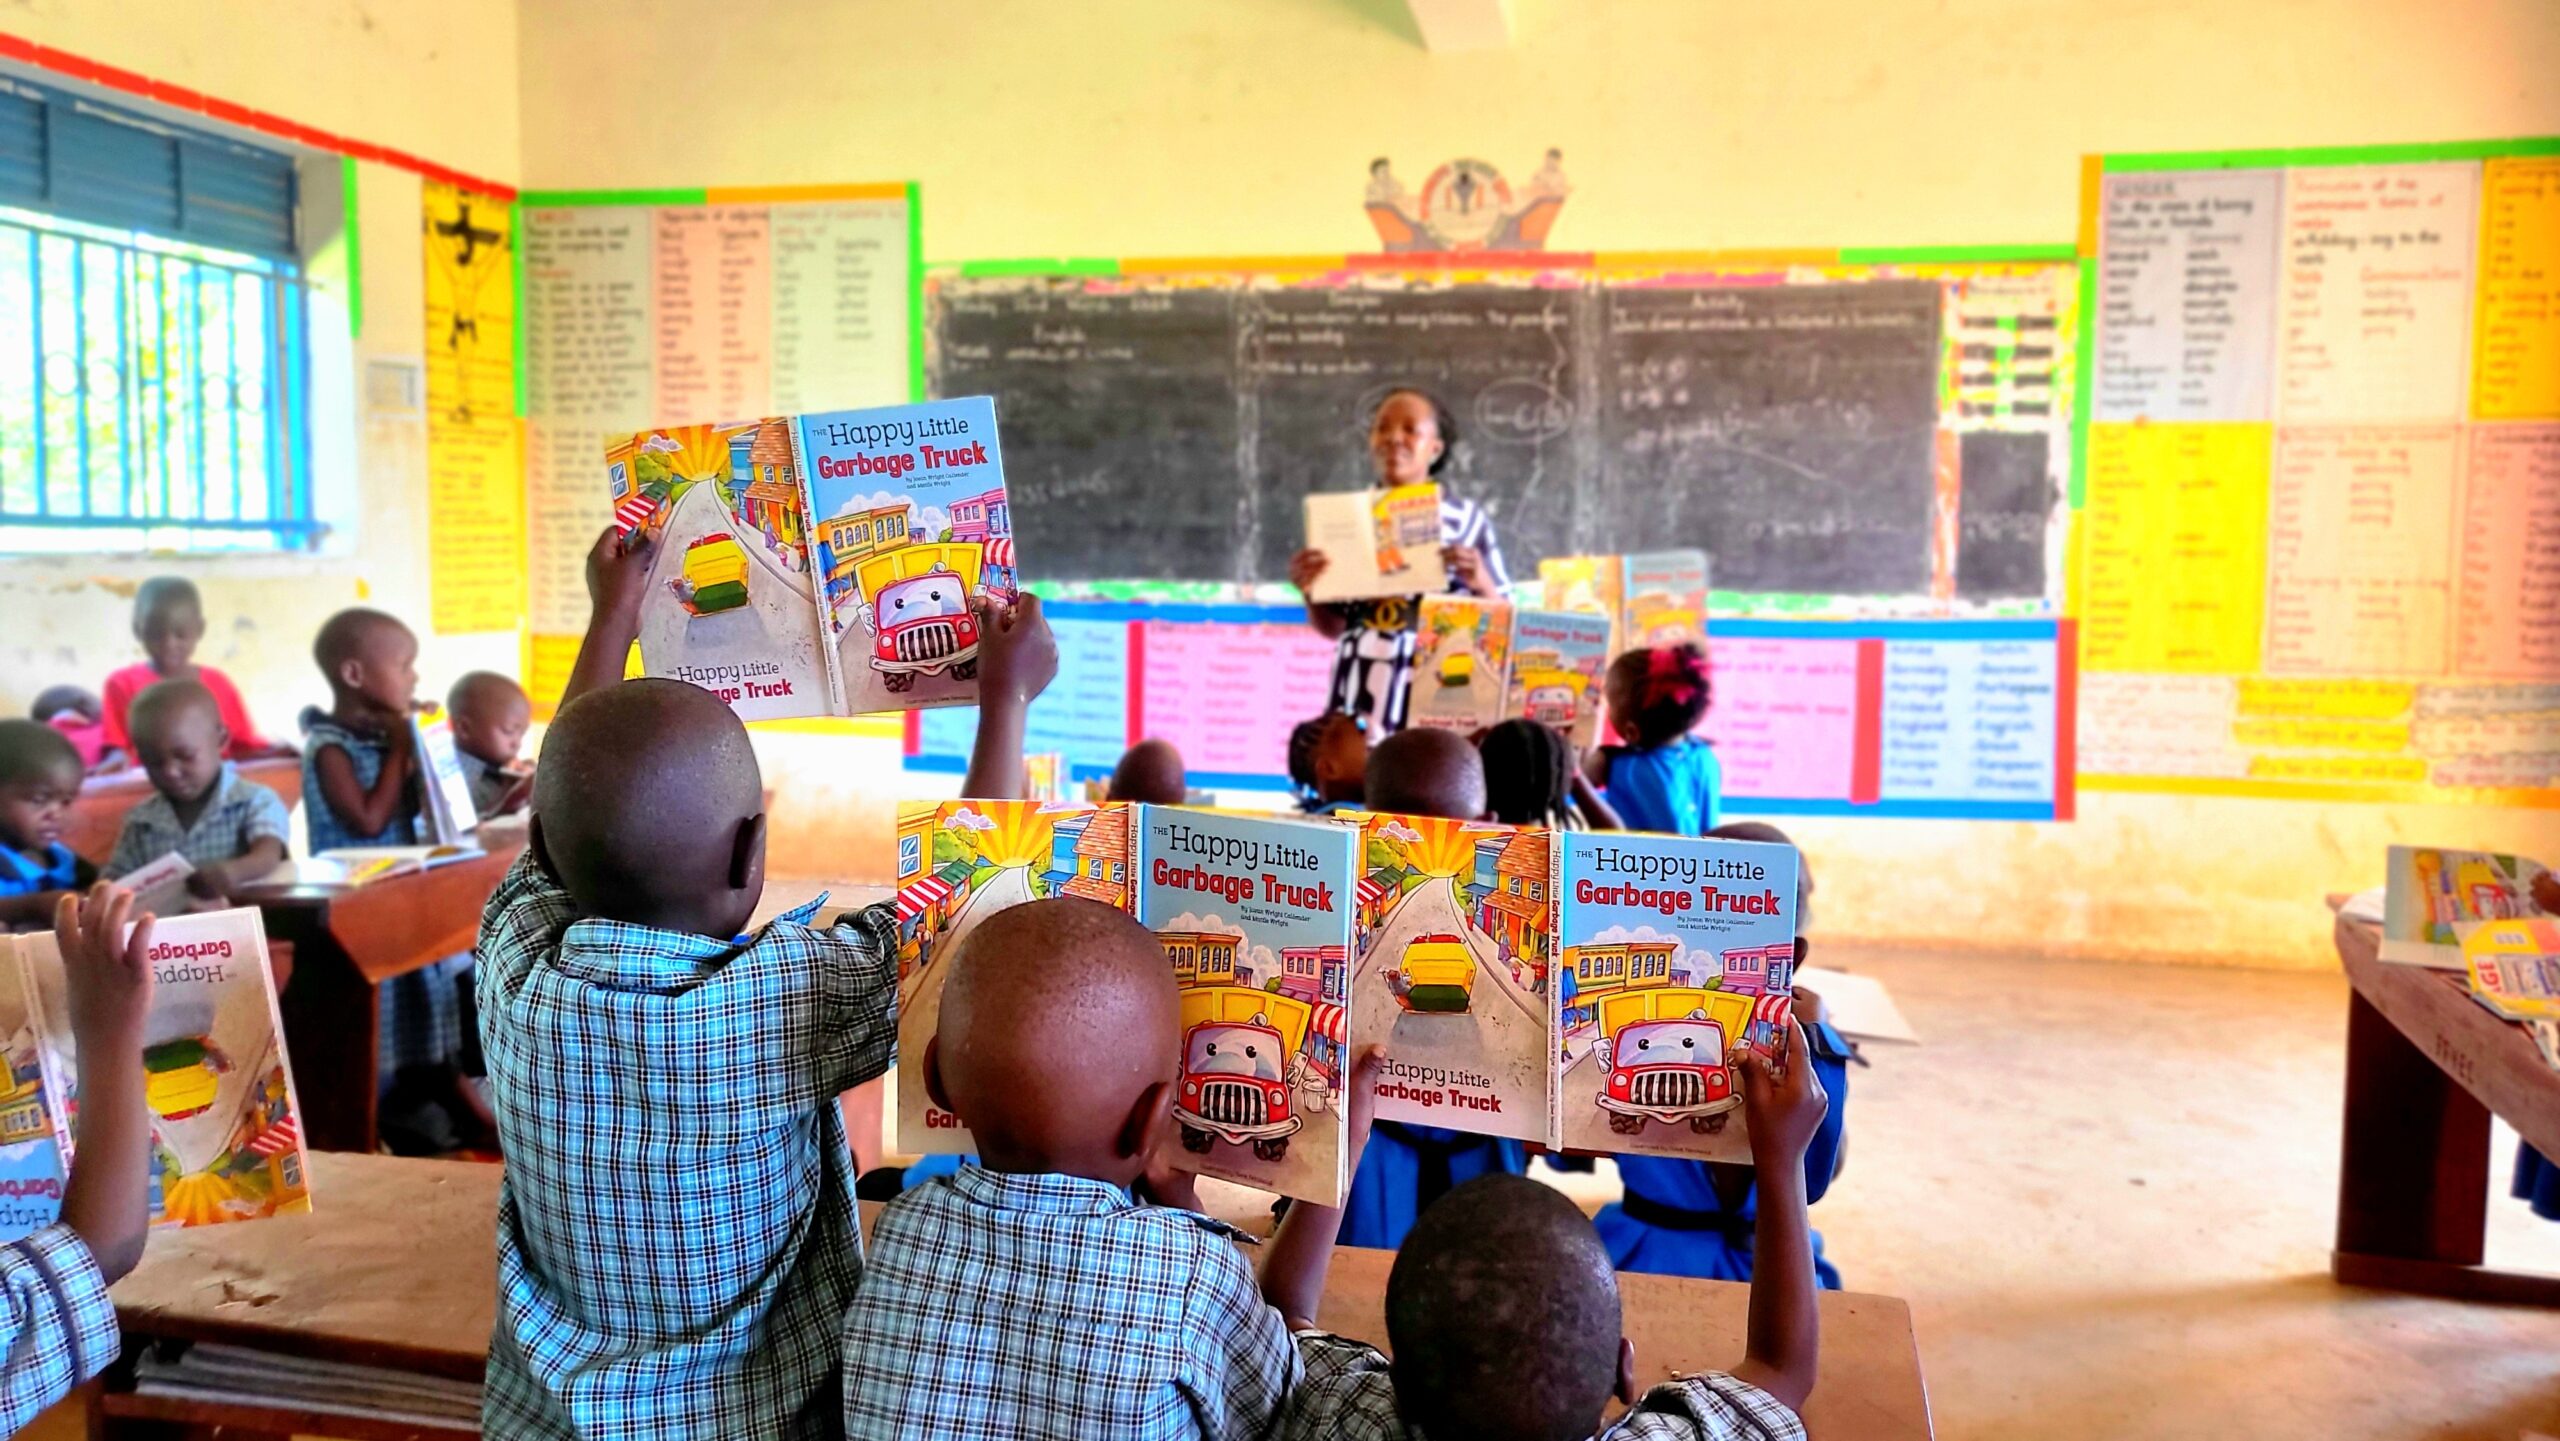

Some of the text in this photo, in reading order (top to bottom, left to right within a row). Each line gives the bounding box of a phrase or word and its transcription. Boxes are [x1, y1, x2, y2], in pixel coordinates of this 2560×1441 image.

[813, 418, 969, 448] THE Happy Little
[817, 440, 988, 479] Garbage Truck
[798, 478, 808, 510] Garbage
[803, 511, 814, 533] Truck
[1520, 625, 1603, 643] Garbage Truck
[677, 660, 779, 684] Happy Little
[744, 679, 793, 698] Truck
[1129, 825, 1138, 858] Happy
[1153, 824, 1319, 871] THE Happy Little
[1551, 850, 1561, 880] Happy
[1576, 847, 1765, 884] THE Happy Little
[1129, 880, 1138, 916] Garbage
[1153, 858, 1334, 913] Garbage Truck
[1576, 879, 1780, 916] Garbage Truck
[1550, 901, 1560, 933] Garbage
[149, 940, 232, 961] Garbage
[1552, 935, 1560, 957] Truck
[1380, 1058, 1490, 1088] Happy Little
[1374, 1081, 1502, 1113] arbage Truck
